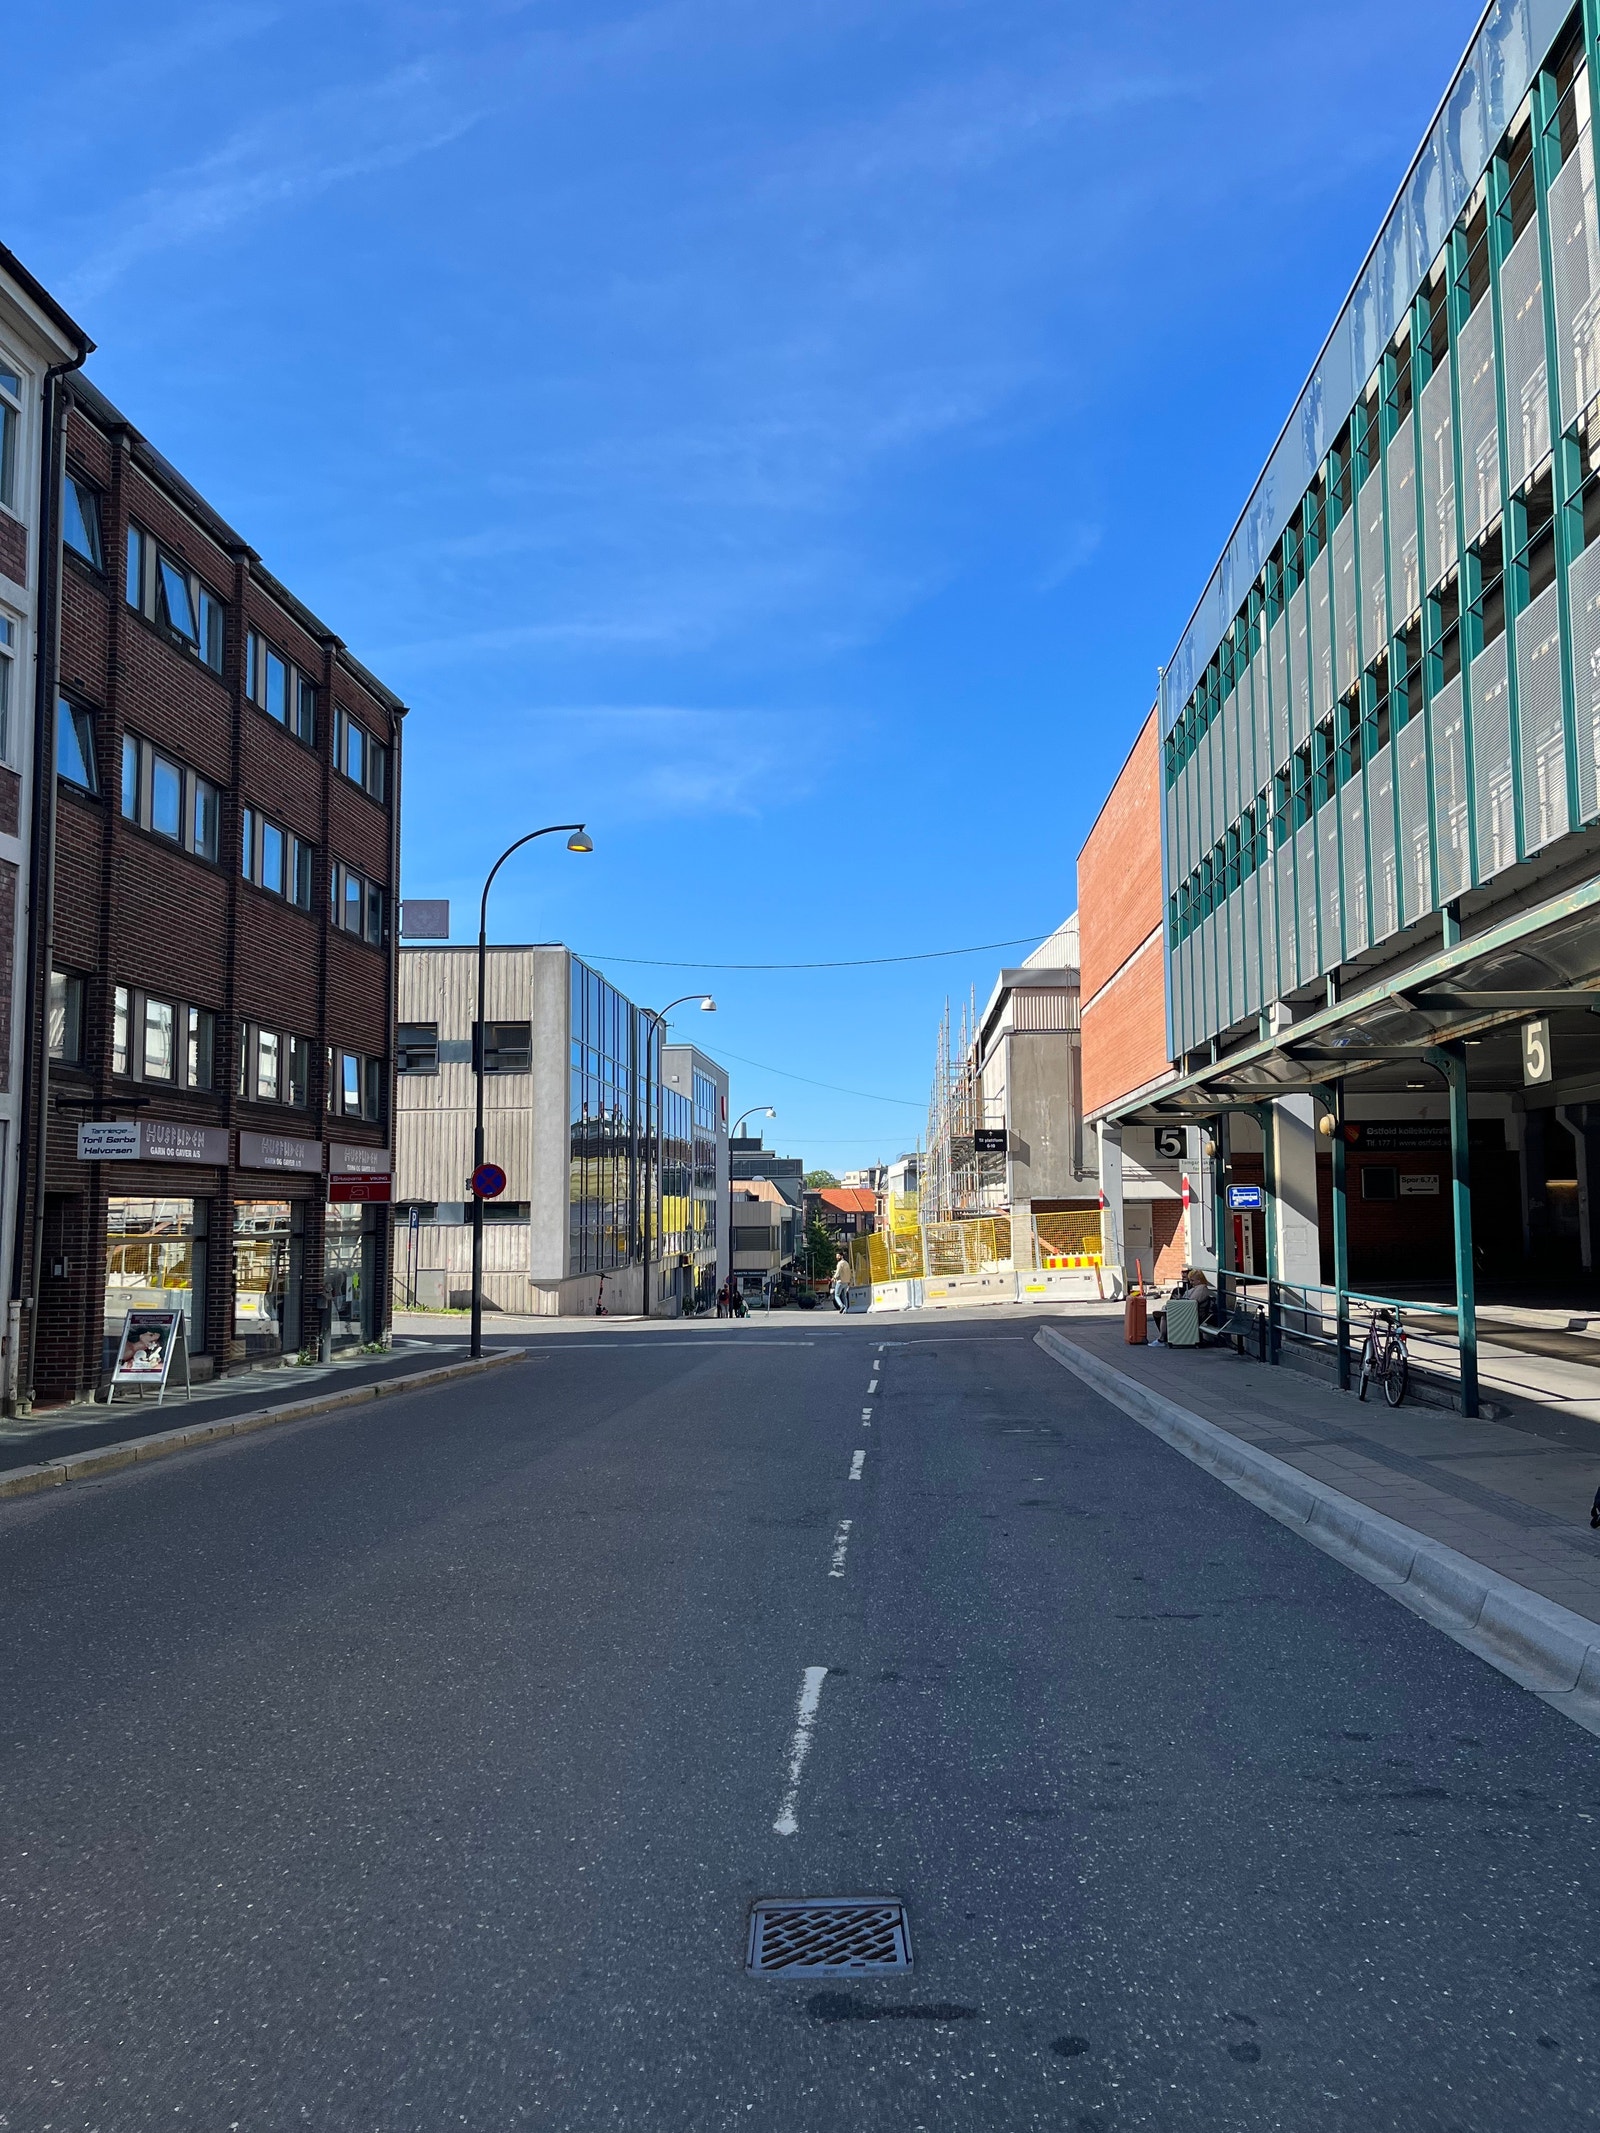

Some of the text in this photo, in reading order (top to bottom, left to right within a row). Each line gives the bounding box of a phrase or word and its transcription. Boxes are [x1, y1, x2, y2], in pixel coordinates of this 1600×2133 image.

[1526, 1022, 1545, 1078] 5
[146, 1123, 205, 1148] HUSFLIDEN
[1366, 1127, 1397, 1135] Østfold
[82, 1135, 136, 1144] Toril Sørbø
[1159, 1129, 1181, 1157] 5
[1378, 1139, 1391, 1147] 177
[84, 1147, 133, 1155] Halvorsen
[150, 1146, 166, 1156] GARN
[166, 1147, 175, 1156] OG
[175, 1148, 192, 1158] GAVER
[1401, 1176, 1418, 1184] Spor
[411, 1212, 417, 1227] P
